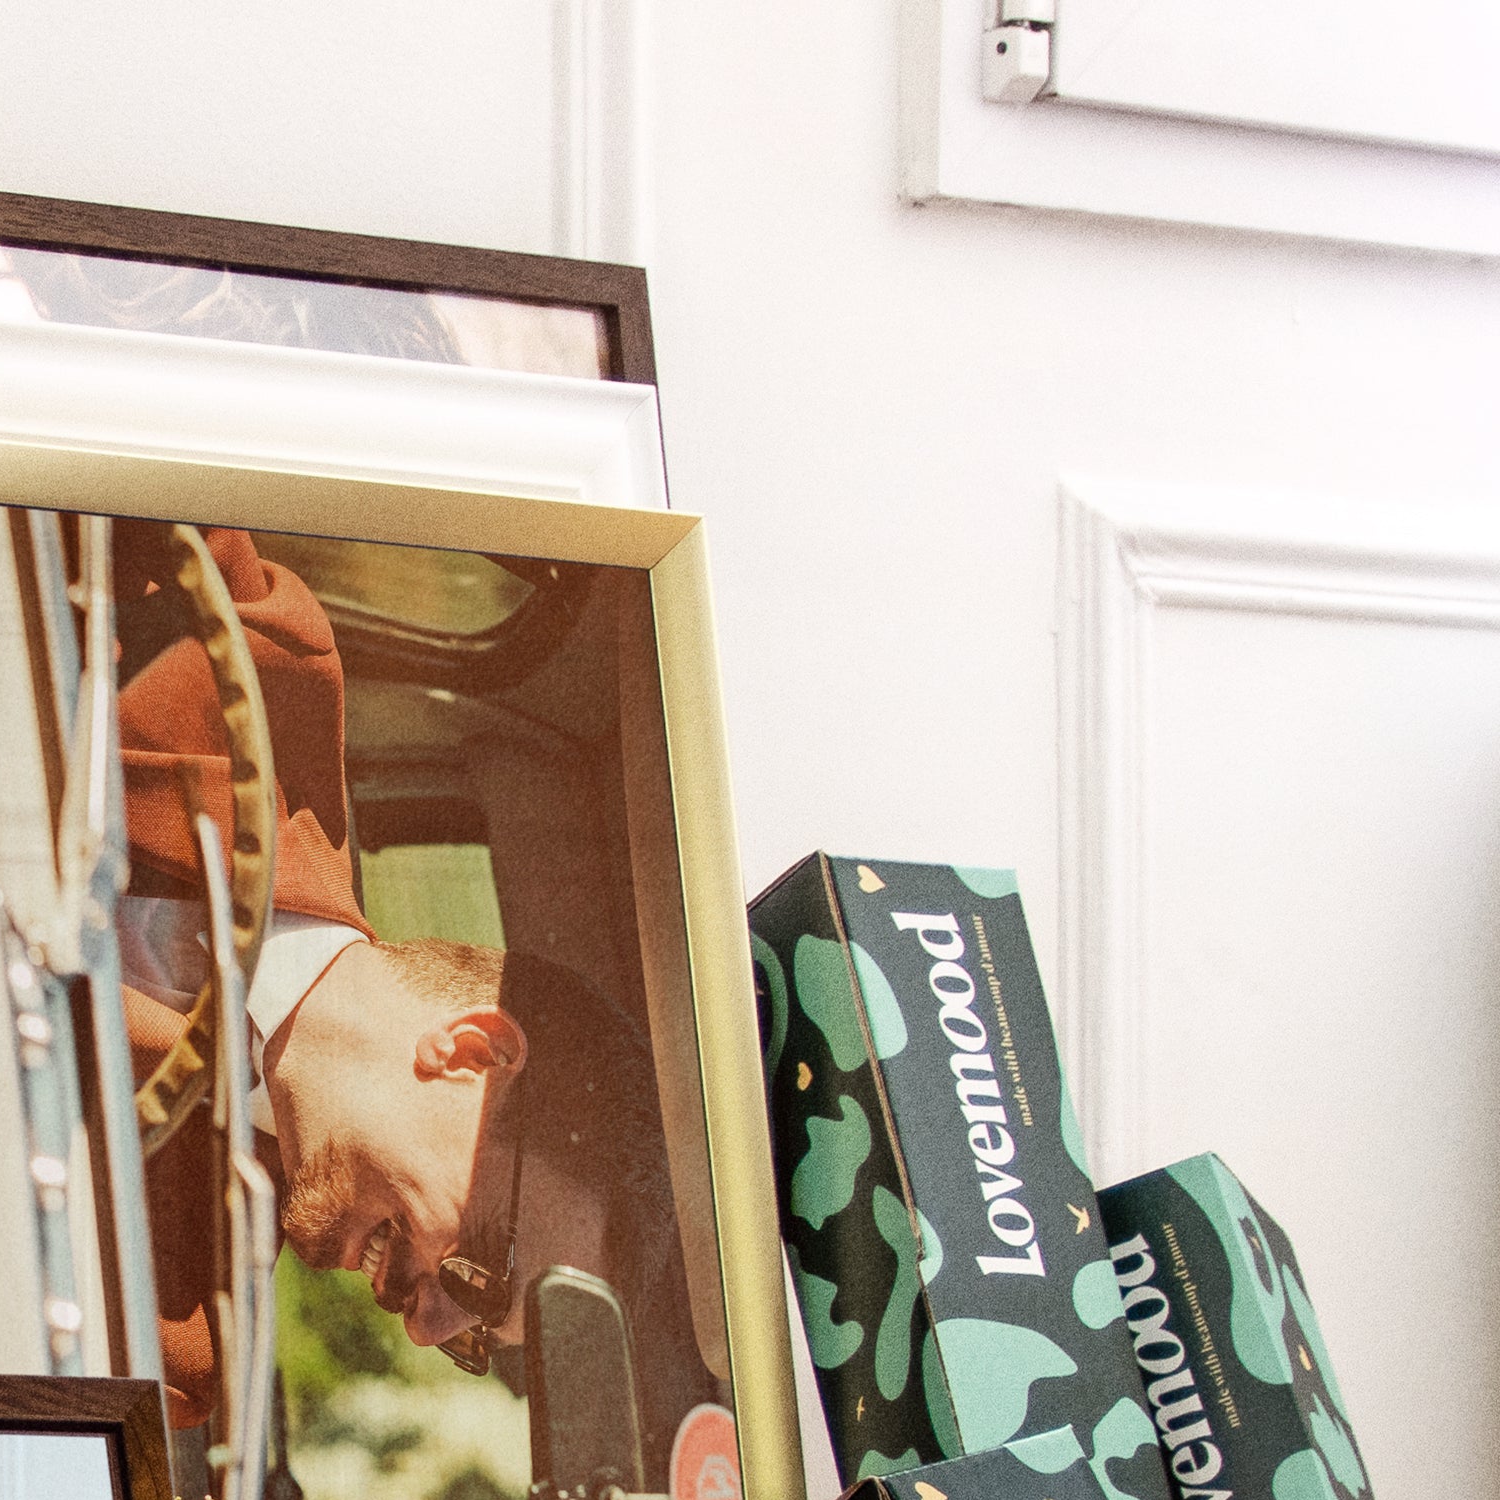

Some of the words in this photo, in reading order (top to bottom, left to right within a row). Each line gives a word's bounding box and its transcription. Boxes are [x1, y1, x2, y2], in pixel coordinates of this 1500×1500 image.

[972, 913, 994, 973] d'amour
[987, 975, 1013, 1047] beaucoup
[1003, 1050, 1020, 1082] with
[890, 911, 1047, 1278] Lovemood
[1013, 1085, 1033, 1125] made
[1162, 1223, 1189, 1279] d'amour
[1182, 1281, 1214, 1352] beaucoup
[1207, 1353, 1224, 1386] with
[1219, 1388, 1240, 1427] made
